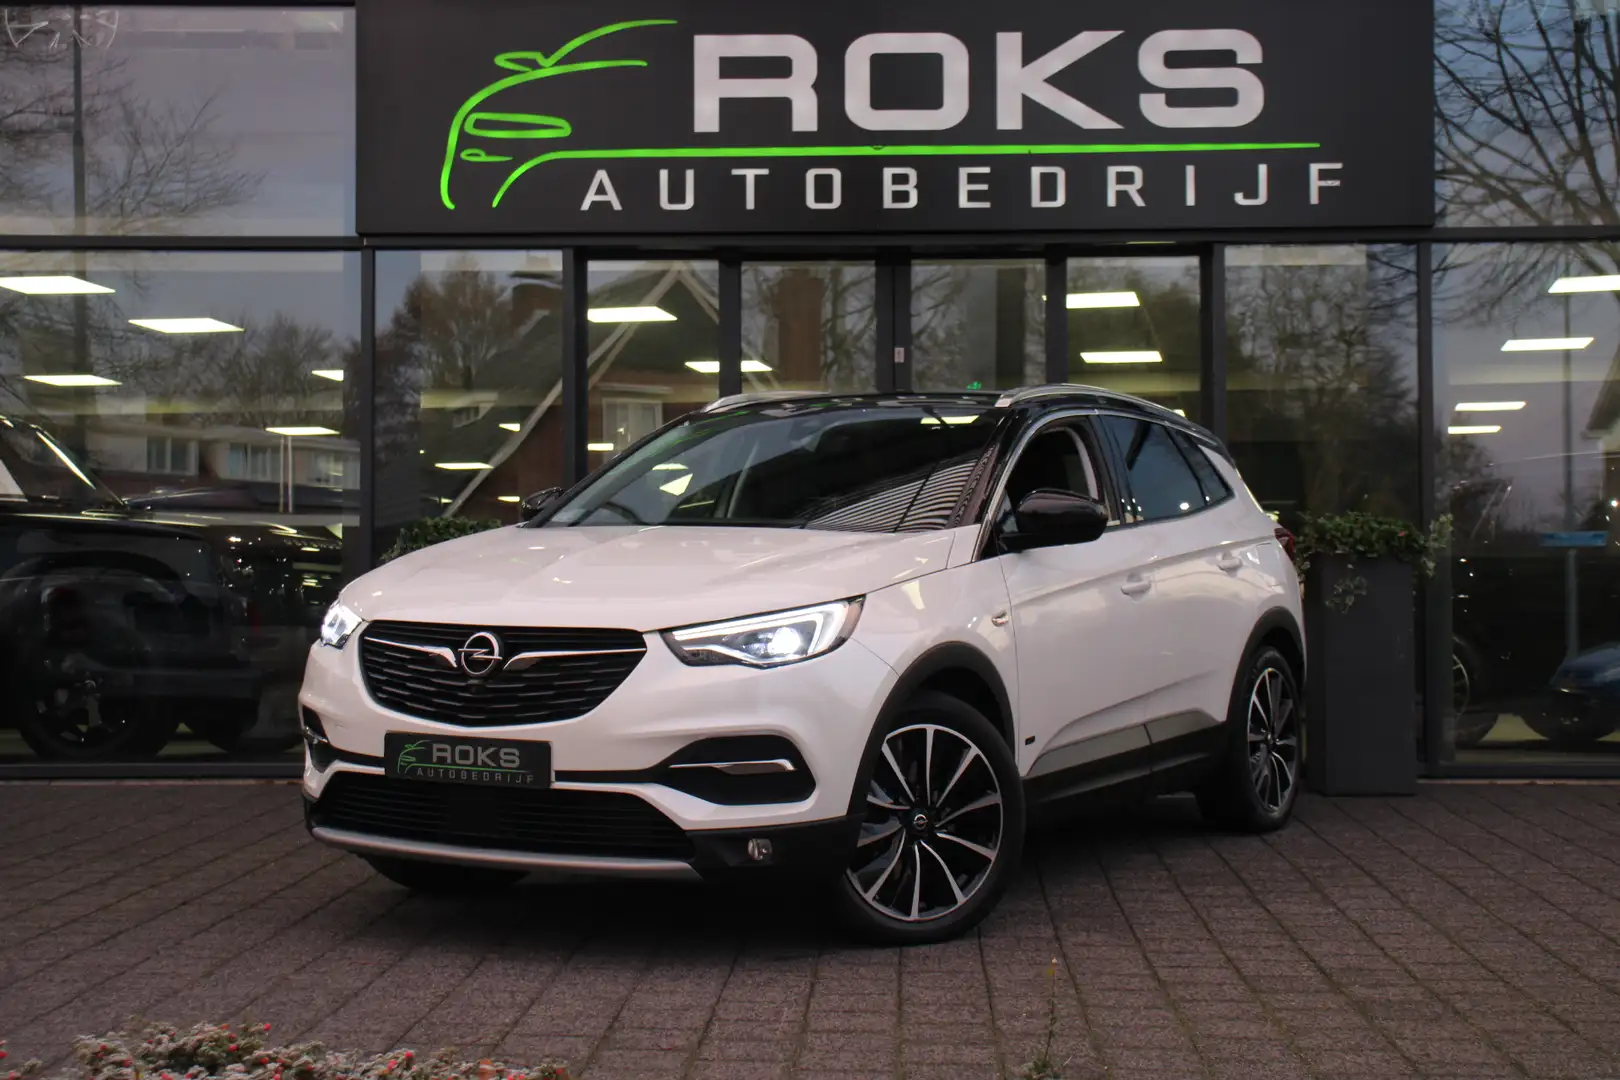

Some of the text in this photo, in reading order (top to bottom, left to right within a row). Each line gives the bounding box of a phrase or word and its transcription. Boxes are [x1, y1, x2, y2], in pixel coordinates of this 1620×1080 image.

[693, 28, 1265, 133] ROKS
[580, 163, 1343, 211] AUTOBEDRIJF
[432, 743, 520, 768] ROKS
[416, 767, 534, 784] AUTOBEDRIJF
